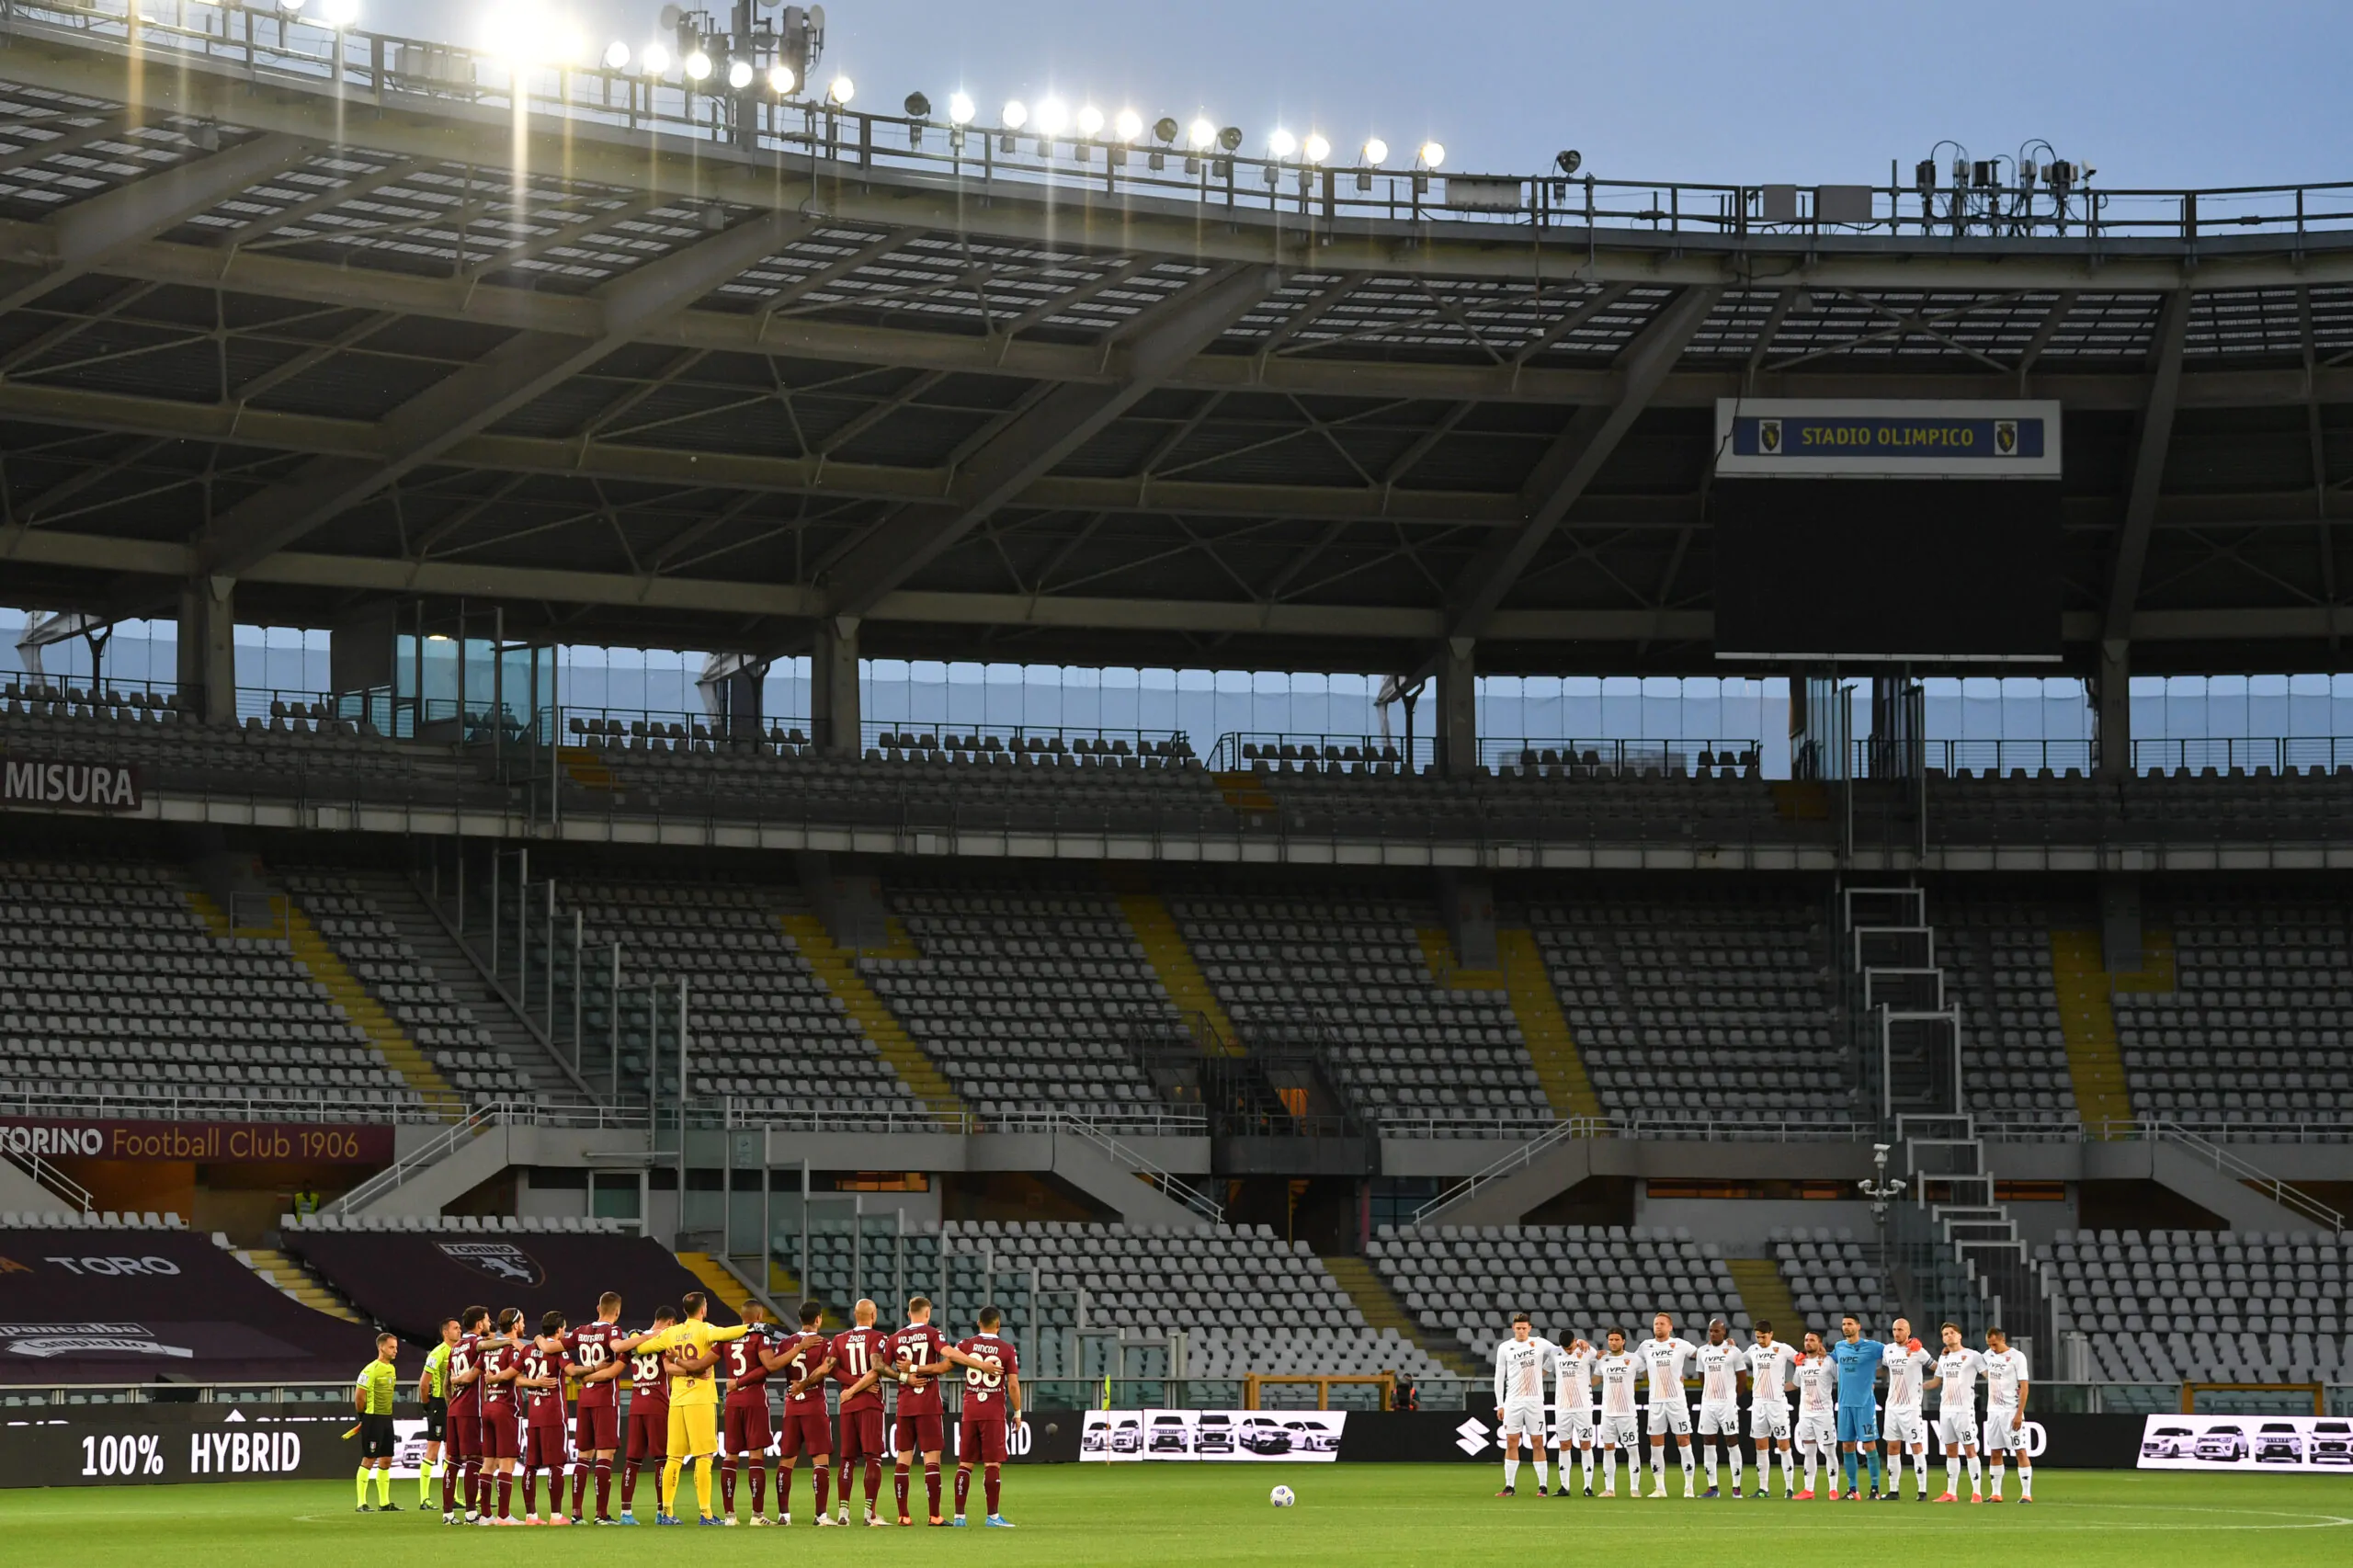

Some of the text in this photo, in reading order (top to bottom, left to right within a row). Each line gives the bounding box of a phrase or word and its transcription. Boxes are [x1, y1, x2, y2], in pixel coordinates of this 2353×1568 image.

[1802, 427, 1973, 446] STADIO OLIMPICO
[5, 761, 135, 806] MISURA
[113, 1128, 220, 1158] Football
[229, 1128, 290, 1158] Club
[300, 1131, 358, 1158] 1906
[43, 1256, 181, 1276] TORO
[0, 1324, 142, 1335] pancalba
[847, 1335, 866, 1343] ZAZA
[972, 1343, 999, 1355] RINCON
[1652, 1349, 1674, 1358] IVPC
[731, 1343, 747, 1377] 3
[845, 1342, 868, 1376] 11
[791, 1353, 808, 1383] 5
[1538, 1421, 1544, 1432] 7
[1582, 1426, 1593, 1438] 20
[1678, 1421, 1688, 1432] 15
[1725, 1421, 1735, 1432] 14
[1774, 1426, 1787, 1437] 93
[1862, 1424, 1872, 1435] 12
[1622, 1431, 1635, 1443] 56
[1824, 1430, 1829, 1441] 3
[1911, 1428, 1918, 1440] 5
[1961, 1430, 1972, 1442] 18
[2010, 1435, 2020, 1447] 16
[82, 1431, 301, 1476] 100% HYBRID
